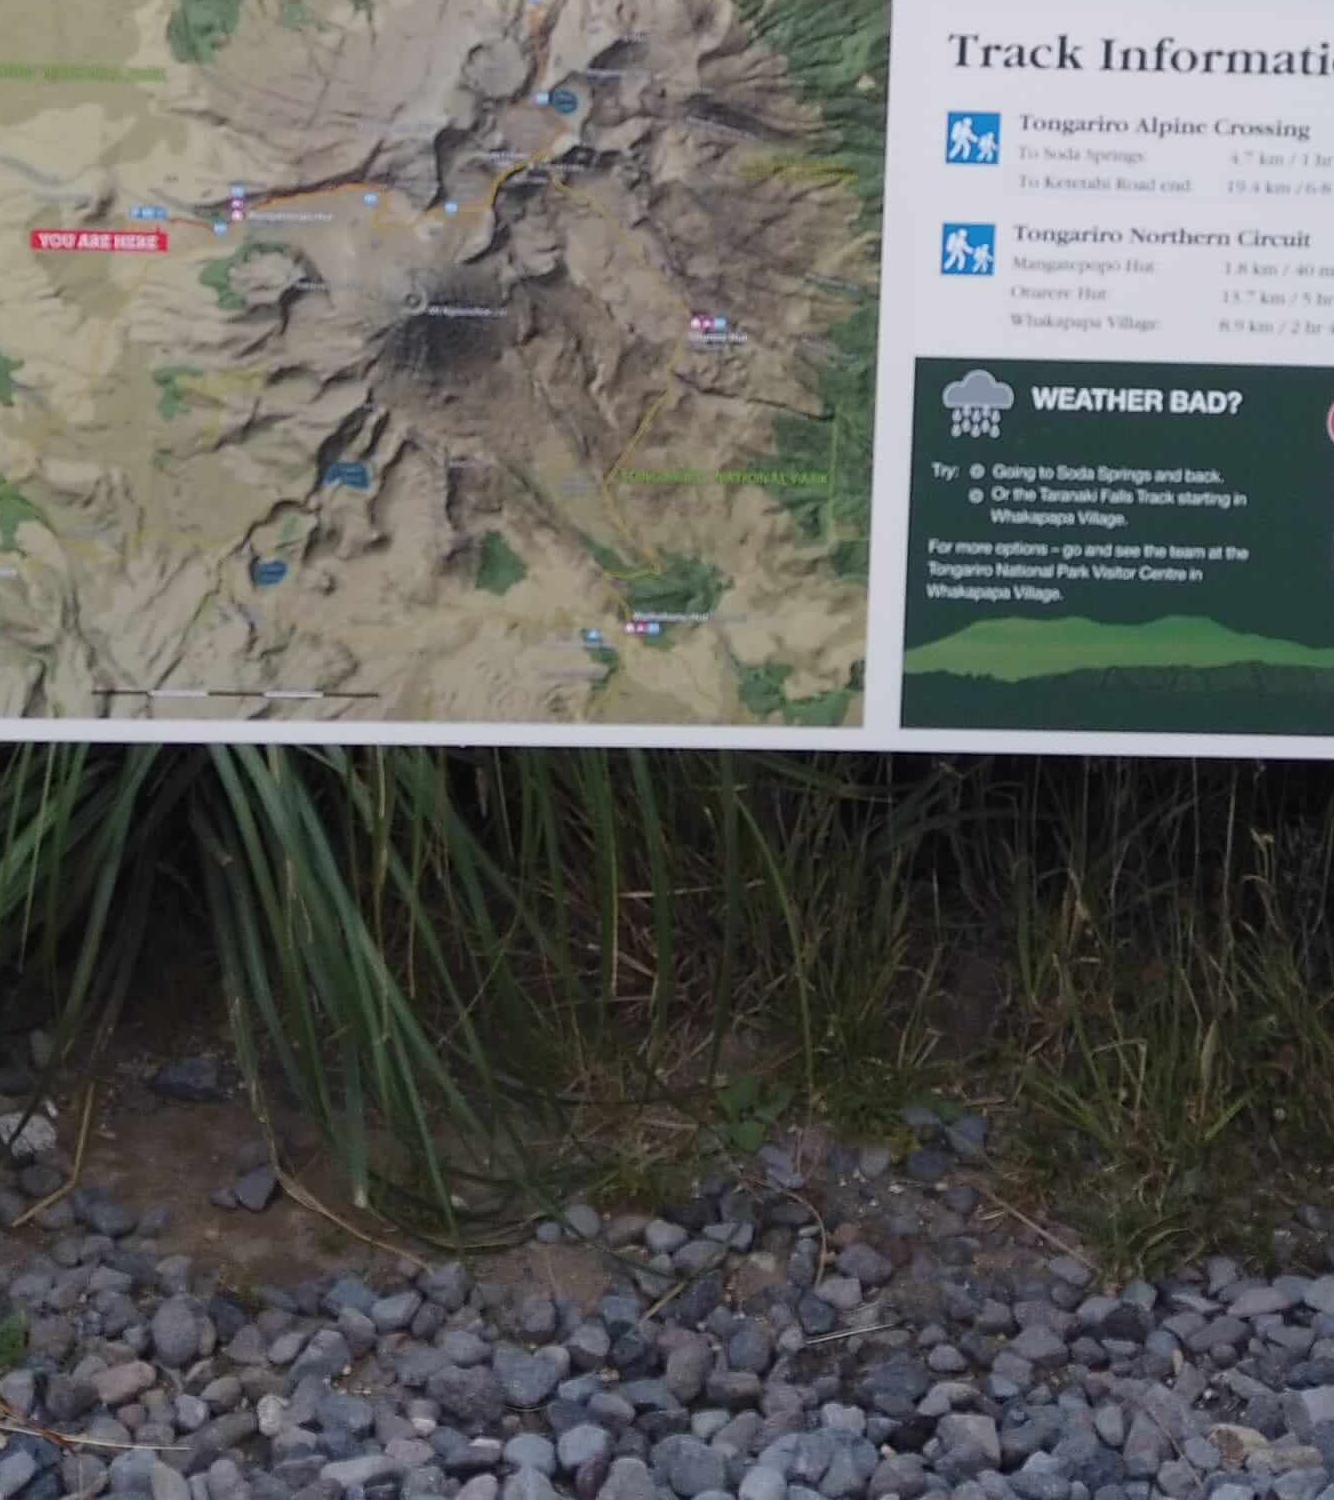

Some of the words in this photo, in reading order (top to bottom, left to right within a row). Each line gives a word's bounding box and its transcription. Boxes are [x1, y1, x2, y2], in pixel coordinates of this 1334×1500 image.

[949, 35, 1081, 68] Track
[1020, 115, 1128, 134] Tongariro
[1136, 117, 1207, 137] Alpine
[1213, 121, 1310, 140] Crossing
[37, 233, 76, 248] YOU
[78, 234, 110, 249] ARE
[114, 234, 156, 251] HERE
[1014, 226, 1123, 244] Tongariro
[1130, 228, 1230, 244] Northern
[1237, 231, 1310, 247] Circuit
[1033, 387, 1161, 411] WEATHER
[1171, 390, 1240, 412] BAD?
